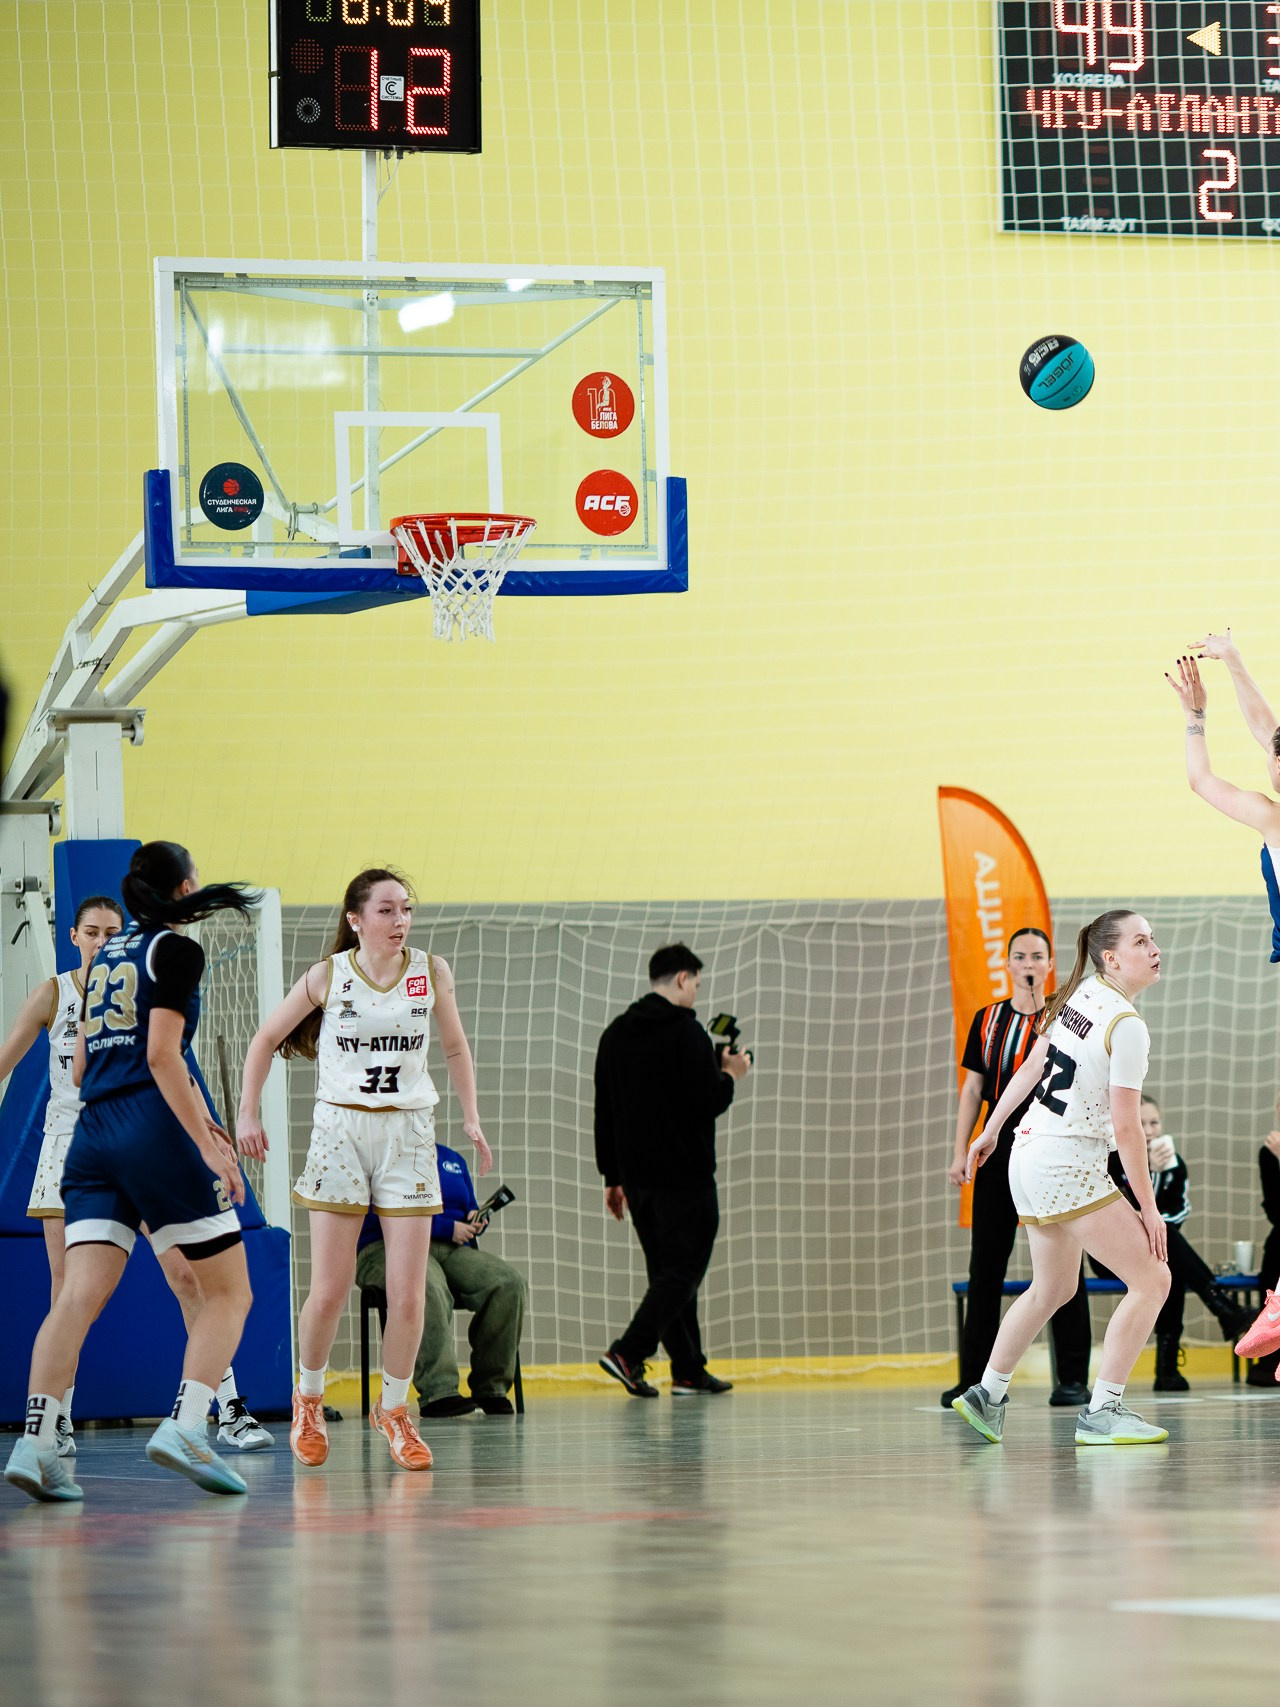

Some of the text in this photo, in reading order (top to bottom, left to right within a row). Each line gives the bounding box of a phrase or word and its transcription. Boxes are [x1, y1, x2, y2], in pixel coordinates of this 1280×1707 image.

[1052, 72, 1126, 88] ХОЗЯЕВА
[370, 48, 451, 136] 12
[1199, 149, 1237, 221] 2
[600, 411, 618, 421] ЛИГА
[591, 420, 618, 430] БЕЛОВА
[207, 498, 257, 506] СТУДЕНЧЕСКАЯ
[408, 978, 425, 988] FON
[408, 986, 426, 995] BET
[85, 961, 138, 1039] 23
[87, 1034, 136, 1053] ЦОЛИФК
[359, 1065, 401, 1094] 33
